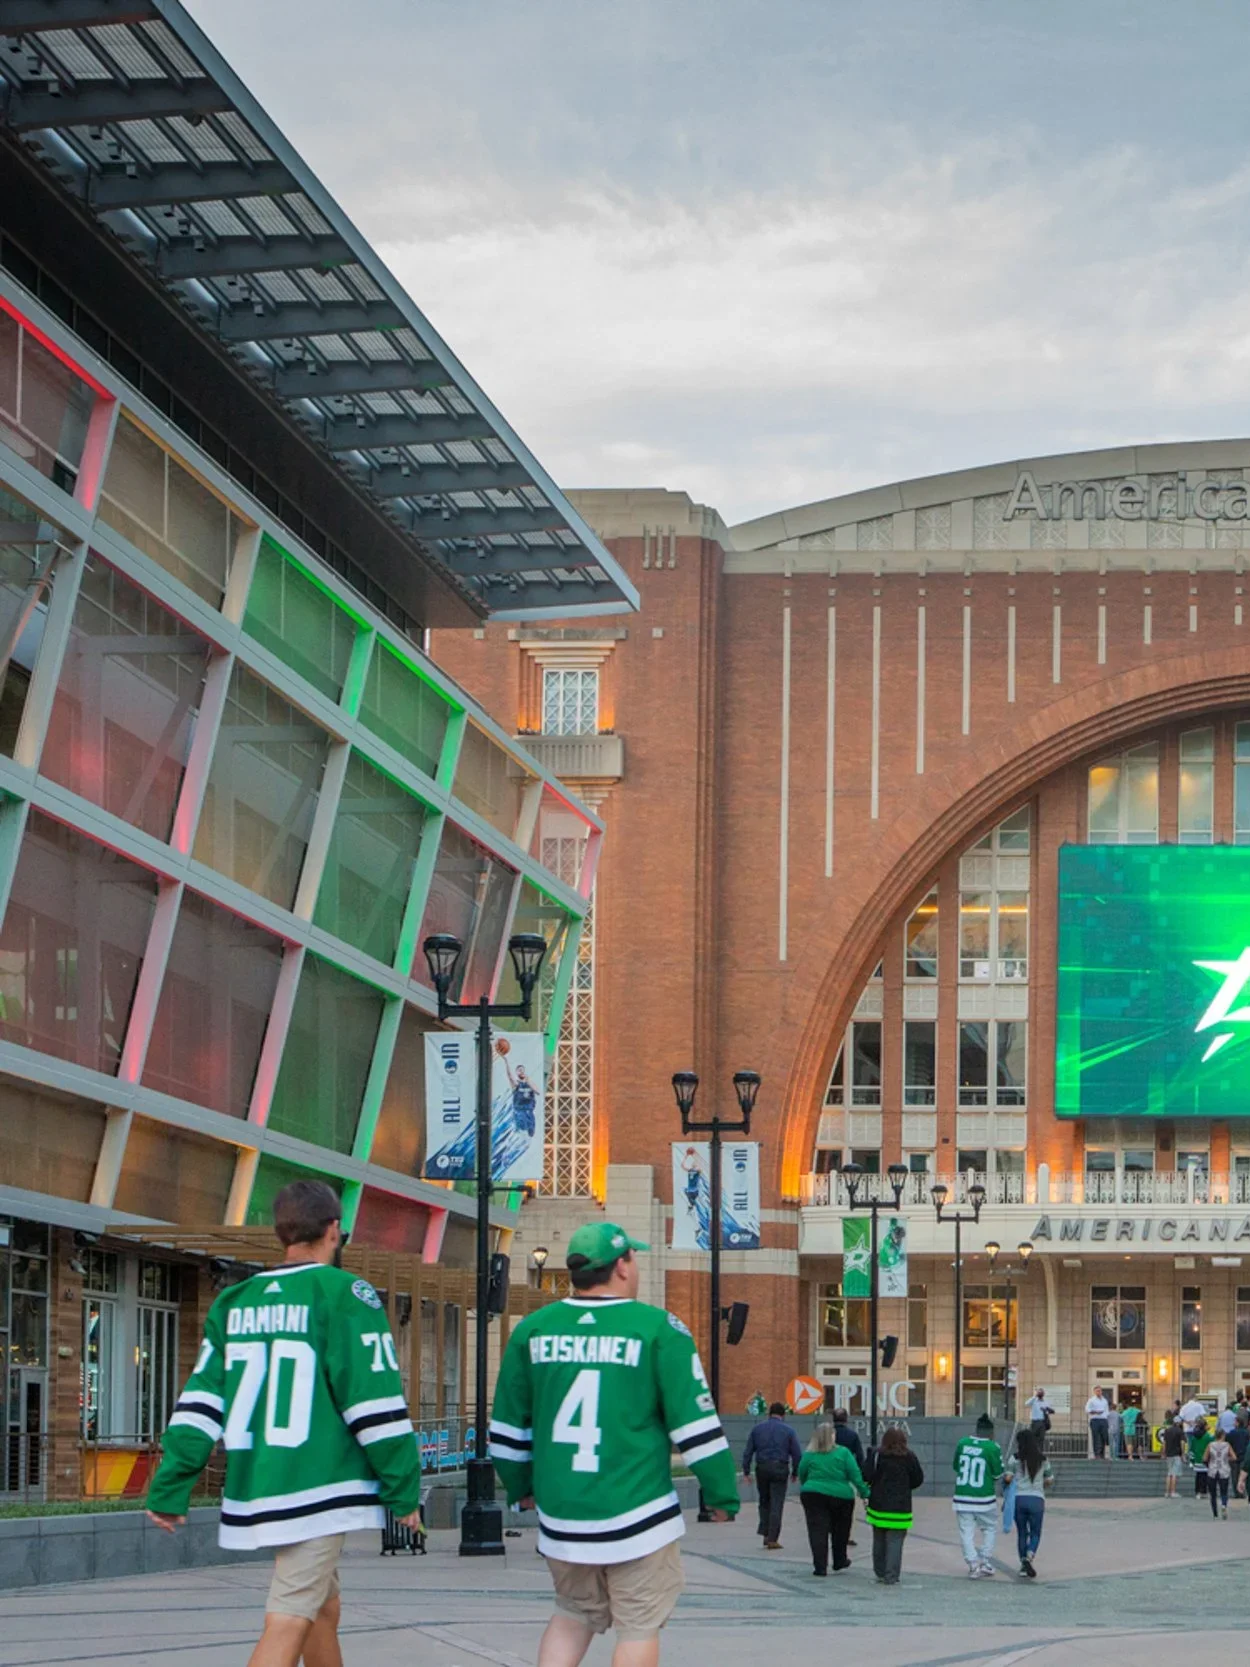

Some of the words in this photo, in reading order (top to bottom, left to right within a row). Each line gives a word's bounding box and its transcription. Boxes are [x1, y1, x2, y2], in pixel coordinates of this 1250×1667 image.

[226, 1303, 310, 1335] DAMIANI
[529, 1334, 643, 1368] HEISKANEN
[223, 1338, 317, 1451] 70
[834, 1381, 917, 1412] PNC
[552, 1369, 603, 1473] 4
[956, 1455, 986, 1488] 30
